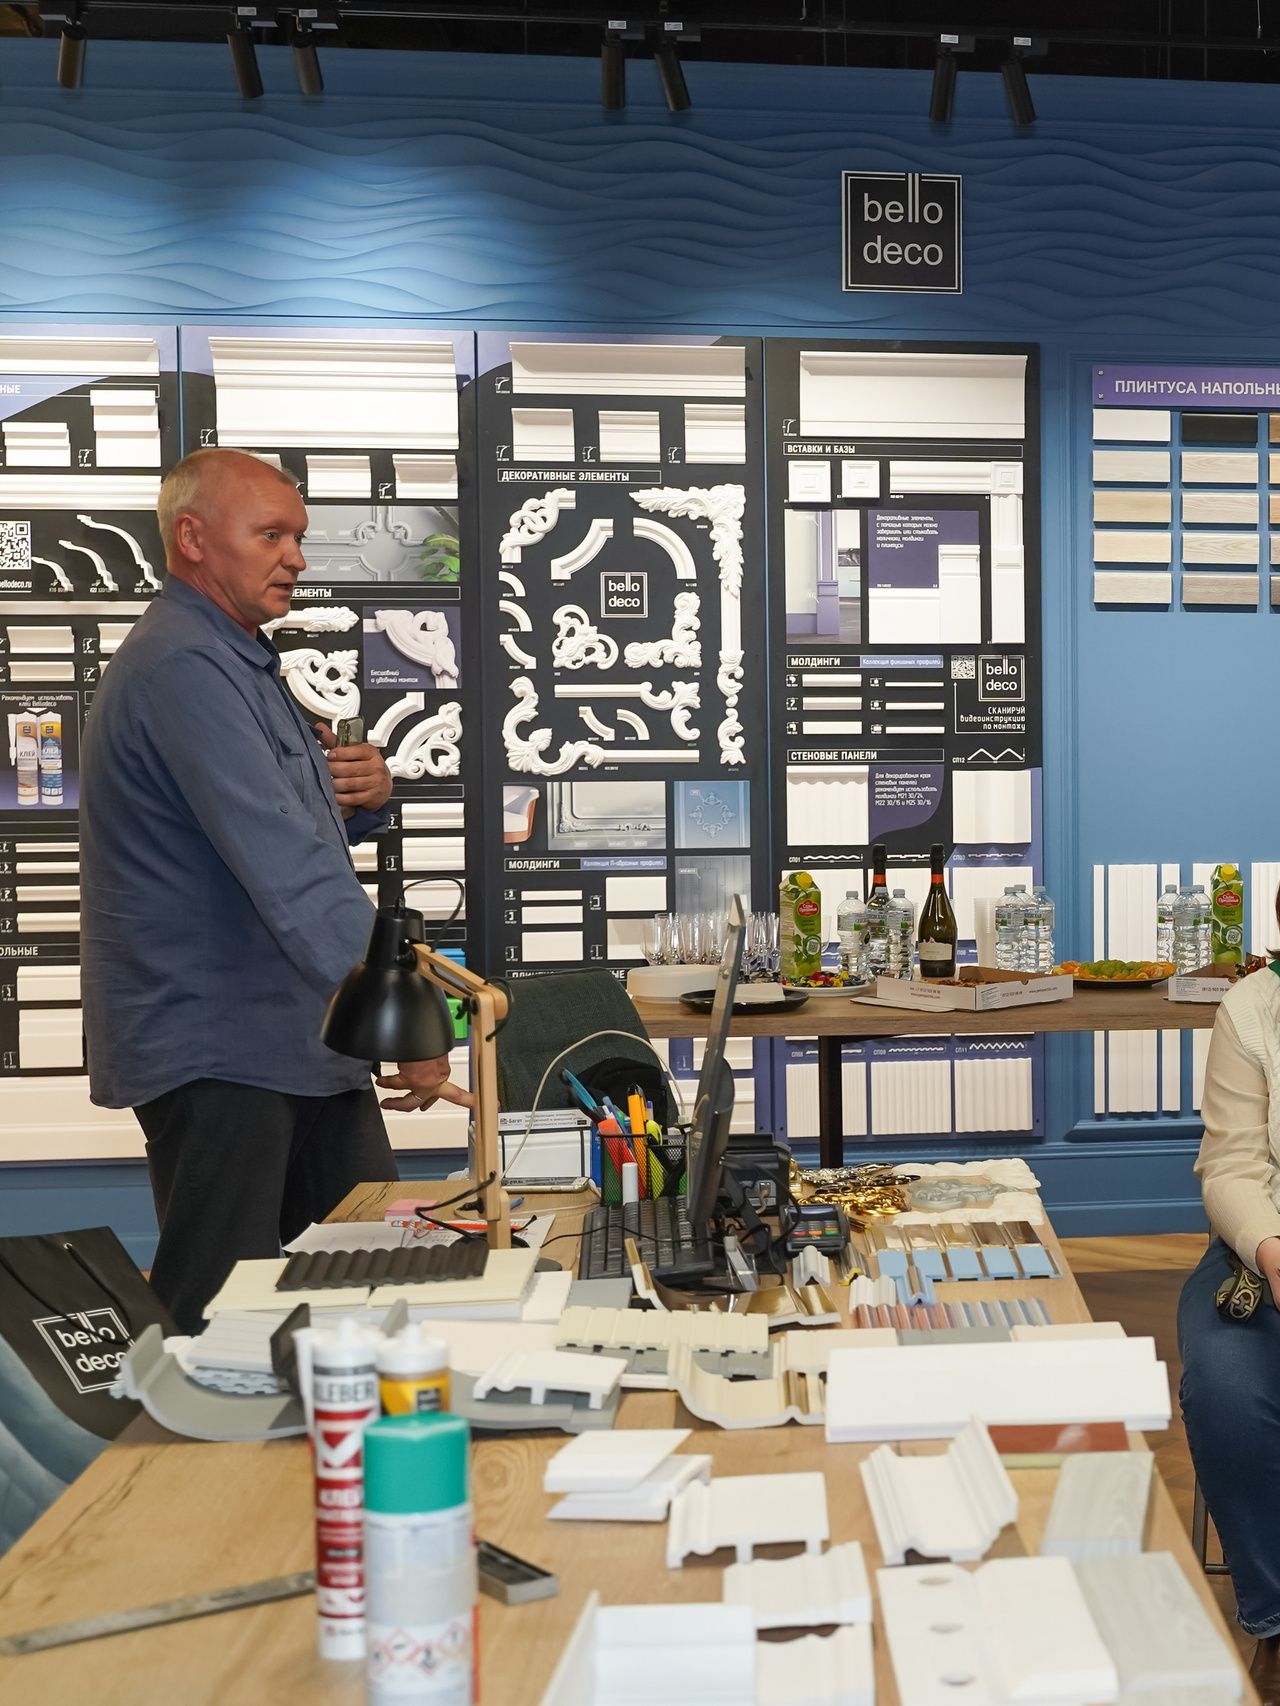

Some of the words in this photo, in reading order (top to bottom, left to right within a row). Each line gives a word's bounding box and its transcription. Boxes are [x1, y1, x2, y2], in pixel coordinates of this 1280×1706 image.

[863, 173, 944, 224] bello
[862, 235, 944, 266] deco
[0, 384, 21, 394] НЫЕ
[1114, 380, 1198, 395] ПЛИНТУСА
[787, 444, 823, 454] ВСТАВКИ
[825, 445, 831, 453] И
[833, 445, 856, 454] БАЗЫ
[501, 471, 576, 482] ДЕКОРАТИВНЫЕ
[578, 471, 630, 482] ЭЛЕМЕНТЫ
[0, 580, 32, 588] ellodeco.ru
[608, 572, 640, 592] bello
[608, 596, 640, 608] deco
[791, 657, 841, 667] МОЛДИНГИ
[986, 655, 1018, 676] bello
[986, 679, 1018, 691] deco
[987, 706, 1026, 714] СКАНИРУЙ
[960, 714, 1026, 723] видеоинструкцию
[993, 723, 1026, 731] монтажу
[791, 751, 839, 761] СТЕНОВЫЕ
[841, 751, 877, 760] ПАНЕЛИ
[508, 860, 560, 870] МОЛДИНГИ
[55, 1312, 117, 1348] bello
